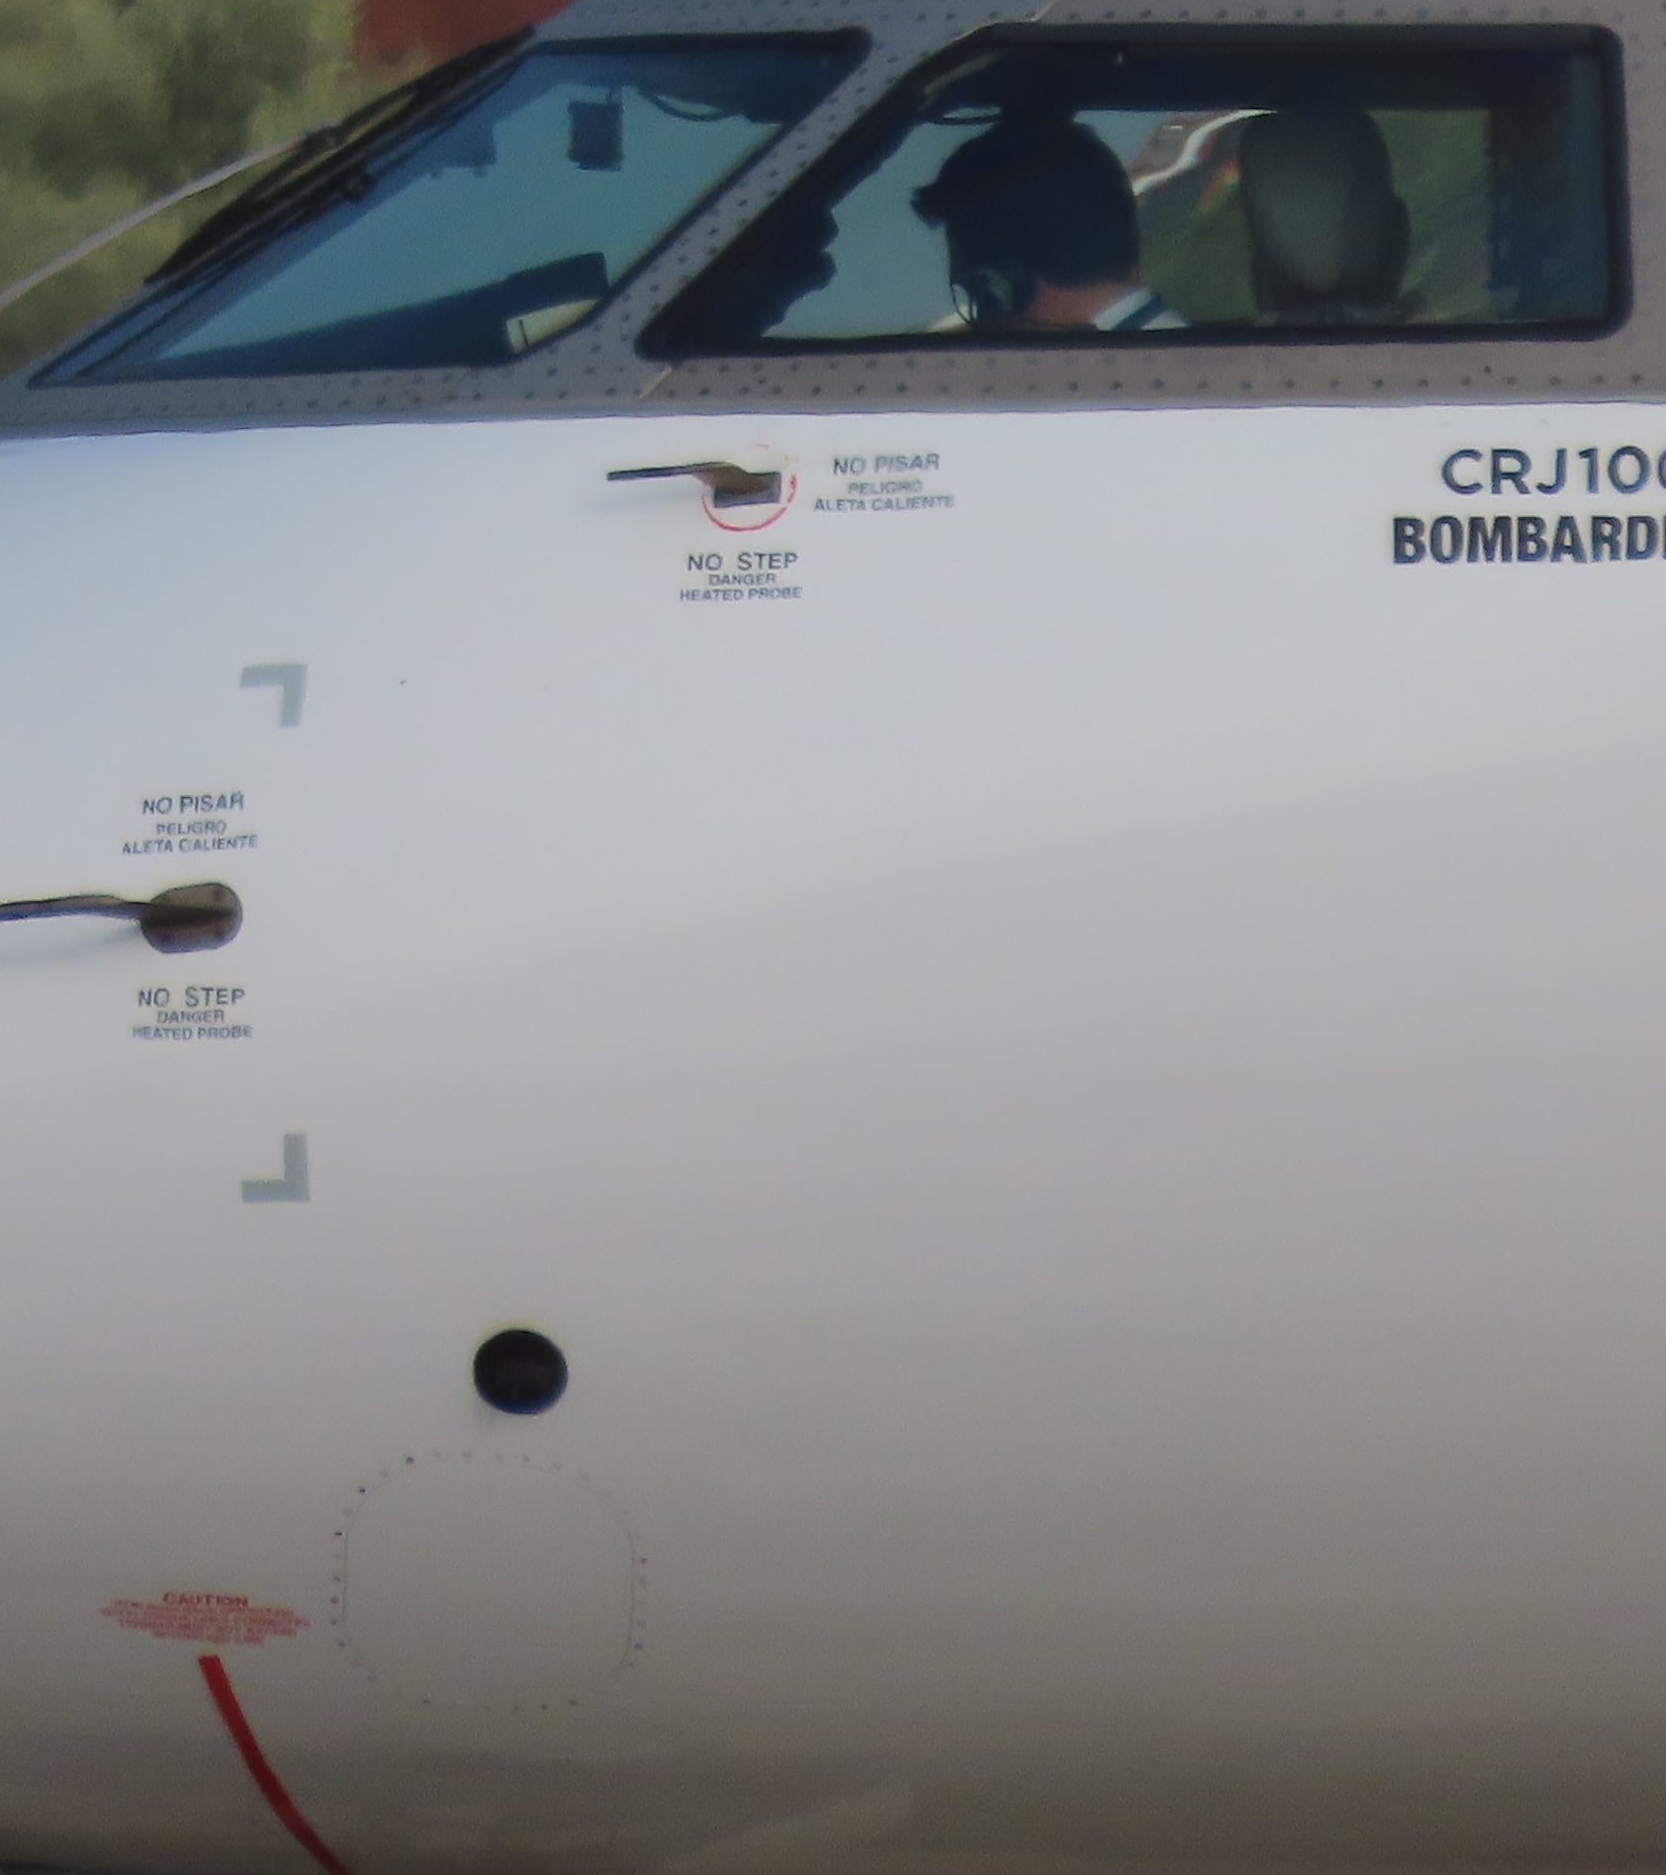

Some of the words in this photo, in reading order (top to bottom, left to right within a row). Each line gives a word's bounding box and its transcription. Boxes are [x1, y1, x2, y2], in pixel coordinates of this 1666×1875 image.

[833, 457, 866, 475] NO
[875, 453, 940, 473] PISAR
[848, 479, 922, 494] PELIGRO
[814, 498, 866, 512] ALETA
[871, 495, 955, 511] CALIENTE
[687, 554, 723, 571] NO
[737, 551, 798, 571] STEP
[708, 573, 777, 586] DANGER
[679, 588, 743, 601] HEATED
[748, 587, 802, 600] PROBE
[142, 797, 173, 815] NO
[180, 791, 244, 813] PISAR
[156, 821, 227, 835] PELIGRO
[122, 840, 173, 854] ALETA
[179, 835, 258, 853] CALIENTE
[138, 988, 170, 1007] NO
[185, 986, 245, 1007] STEP
[158, 1010, 224, 1023] DANGER
[197, 1026, 253, 1039] PROBE
[162, 1591, 248, 1607] CAUTION
